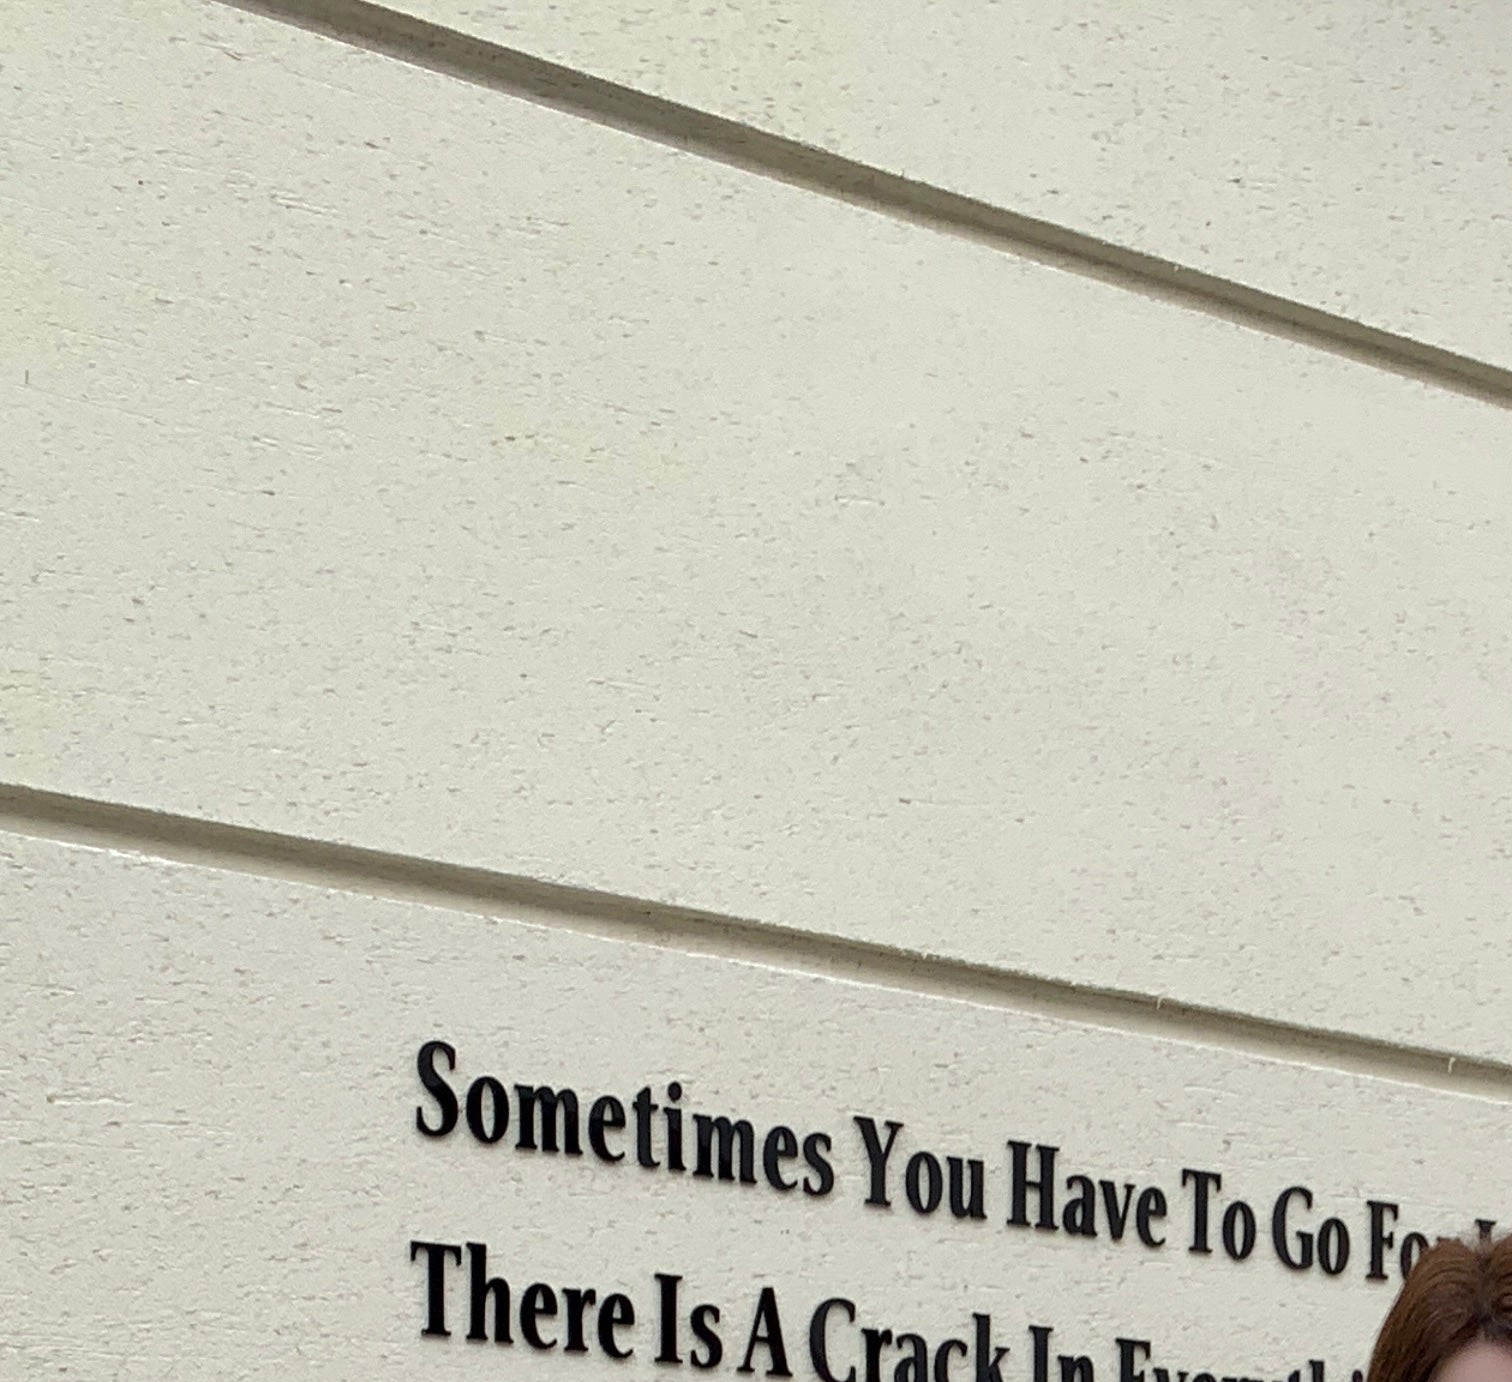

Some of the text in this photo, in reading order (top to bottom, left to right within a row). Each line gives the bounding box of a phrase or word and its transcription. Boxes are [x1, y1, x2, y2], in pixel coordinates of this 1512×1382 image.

[415, 1040, 835, 1199] Sometimes
[852, 1115, 988, 1222] You
[1006, 1139, 1168, 1249] Have
[1181, 1168, 1257, 1263] To
[1271, 1186, 1351, 1279] Go
[409, 1240, 636, 1362] There
[653, 1272, 723, 1372] Is
[736, 1287, 794, 1381] A
